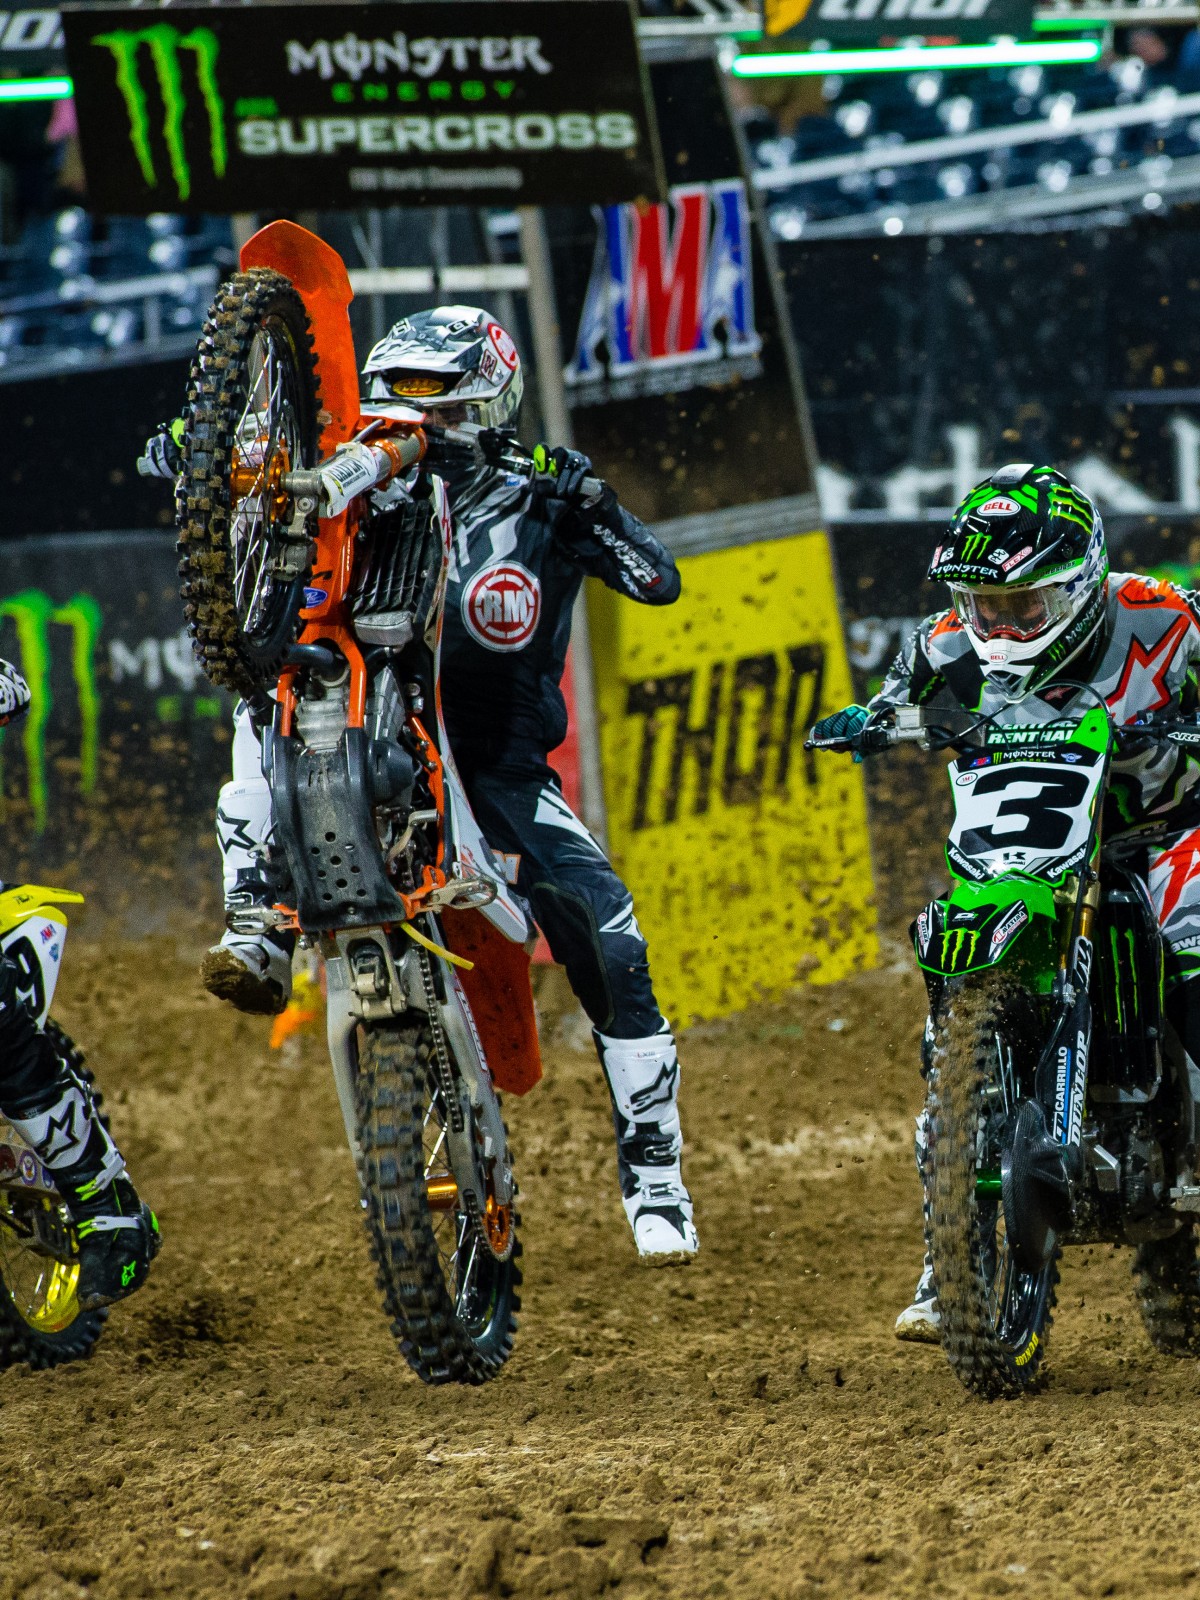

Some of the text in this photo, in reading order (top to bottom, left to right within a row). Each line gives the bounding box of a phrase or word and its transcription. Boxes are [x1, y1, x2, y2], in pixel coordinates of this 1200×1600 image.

[286, 32, 552, 80] MONSTER
[239, 112, 637, 155] SUPERCROSS
[563, 178, 763, 384] AMA
[983, 502, 1013, 512] BELL
[931, 563, 999, 579] MONSTER
[936, 573, 986, 581] ENERGY
[1168, 731, 1200, 742] ARC
[1003, 750, 1057, 760] MONSTER
[959, 766, 1090, 856] 3
[947, 847, 984, 880] Kawasaki
[1047, 844, 1087, 878] Kawasak
[1055, 1046, 1068, 1112] CARRILLO
[1069, 1030, 1090, 1148] DUNLOP
